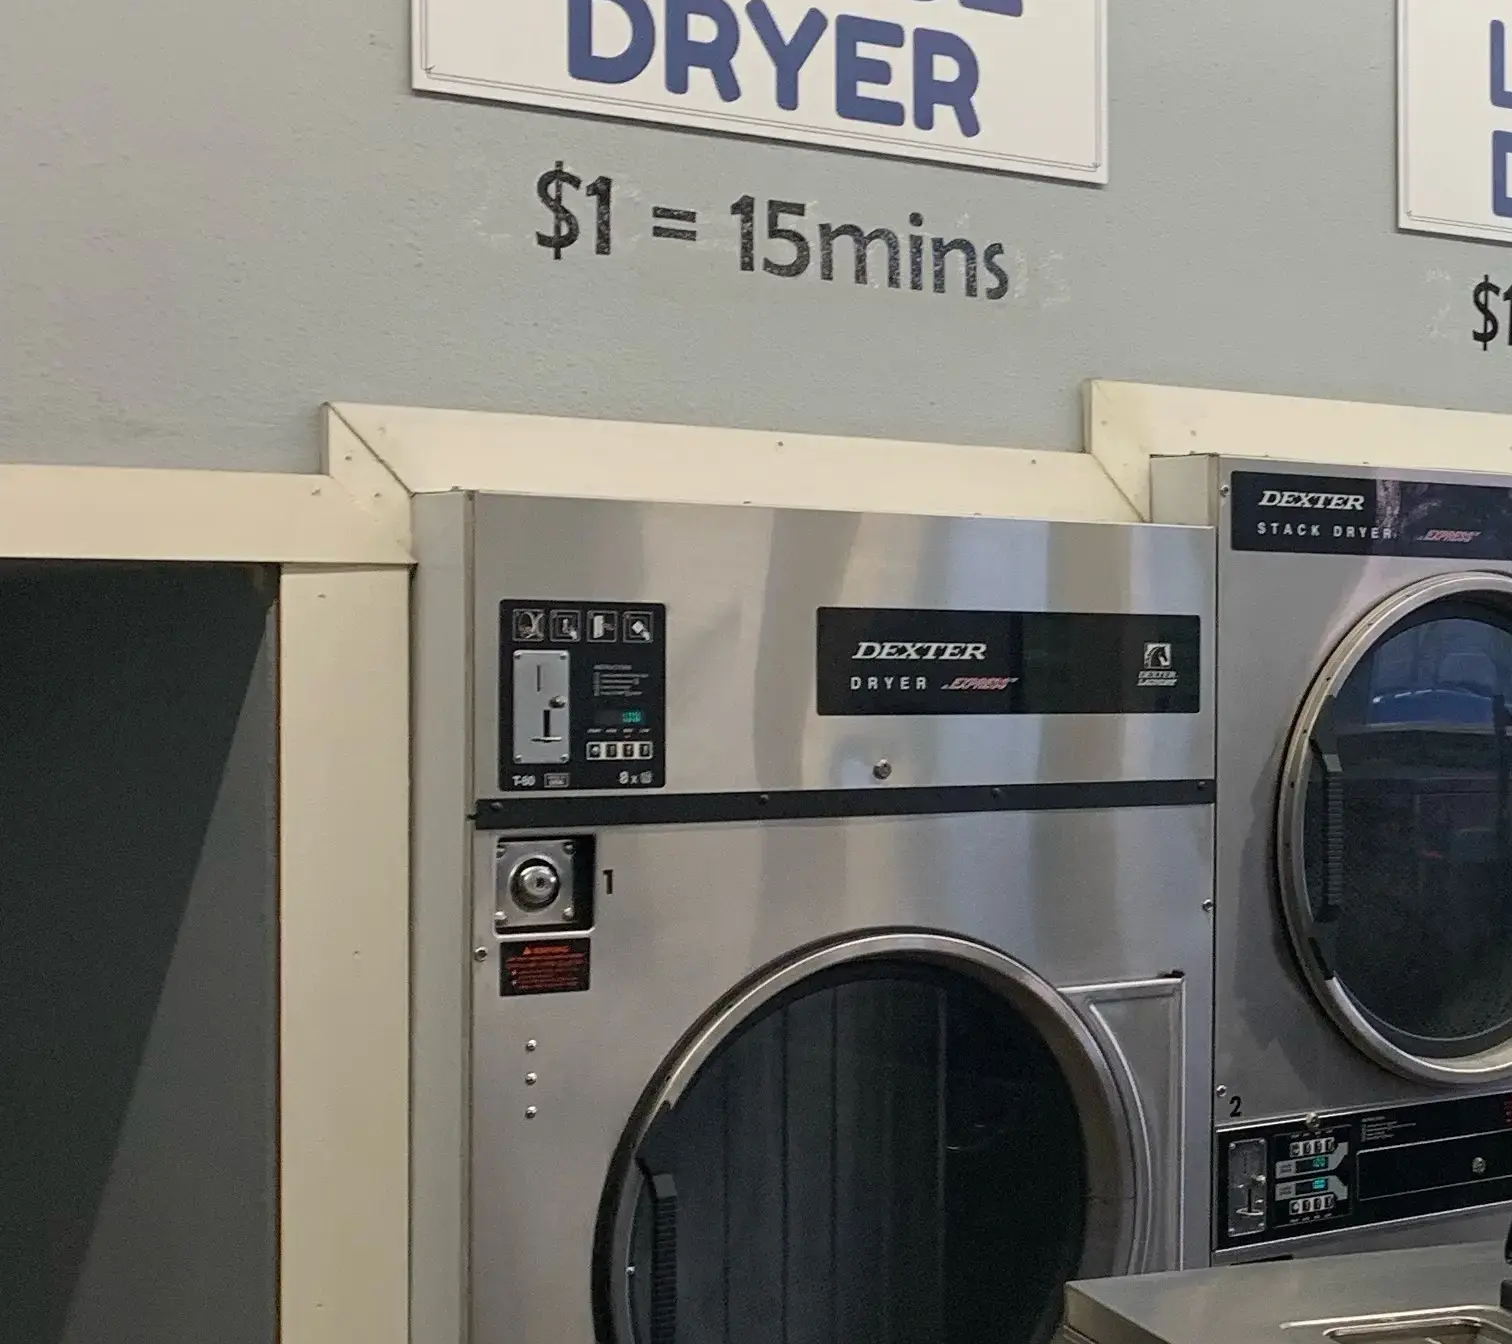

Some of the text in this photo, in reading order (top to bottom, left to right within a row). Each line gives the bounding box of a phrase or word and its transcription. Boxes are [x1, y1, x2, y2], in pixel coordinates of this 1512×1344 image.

[535, 161, 1010, 300] $1 = 15mins
[1258, 490, 1365, 510] DEXTER
[1256, 521, 1321, 536] STACK
[1333, 524, 1393, 539] DRYER
[851, 642, 988, 661] DEXTER
[851, 676, 926, 691] DRYER
[1138, 670, 1178, 679] DEXTER
[602, 869, 614, 895] 1
[1229, 1096, 1243, 1118] 2
